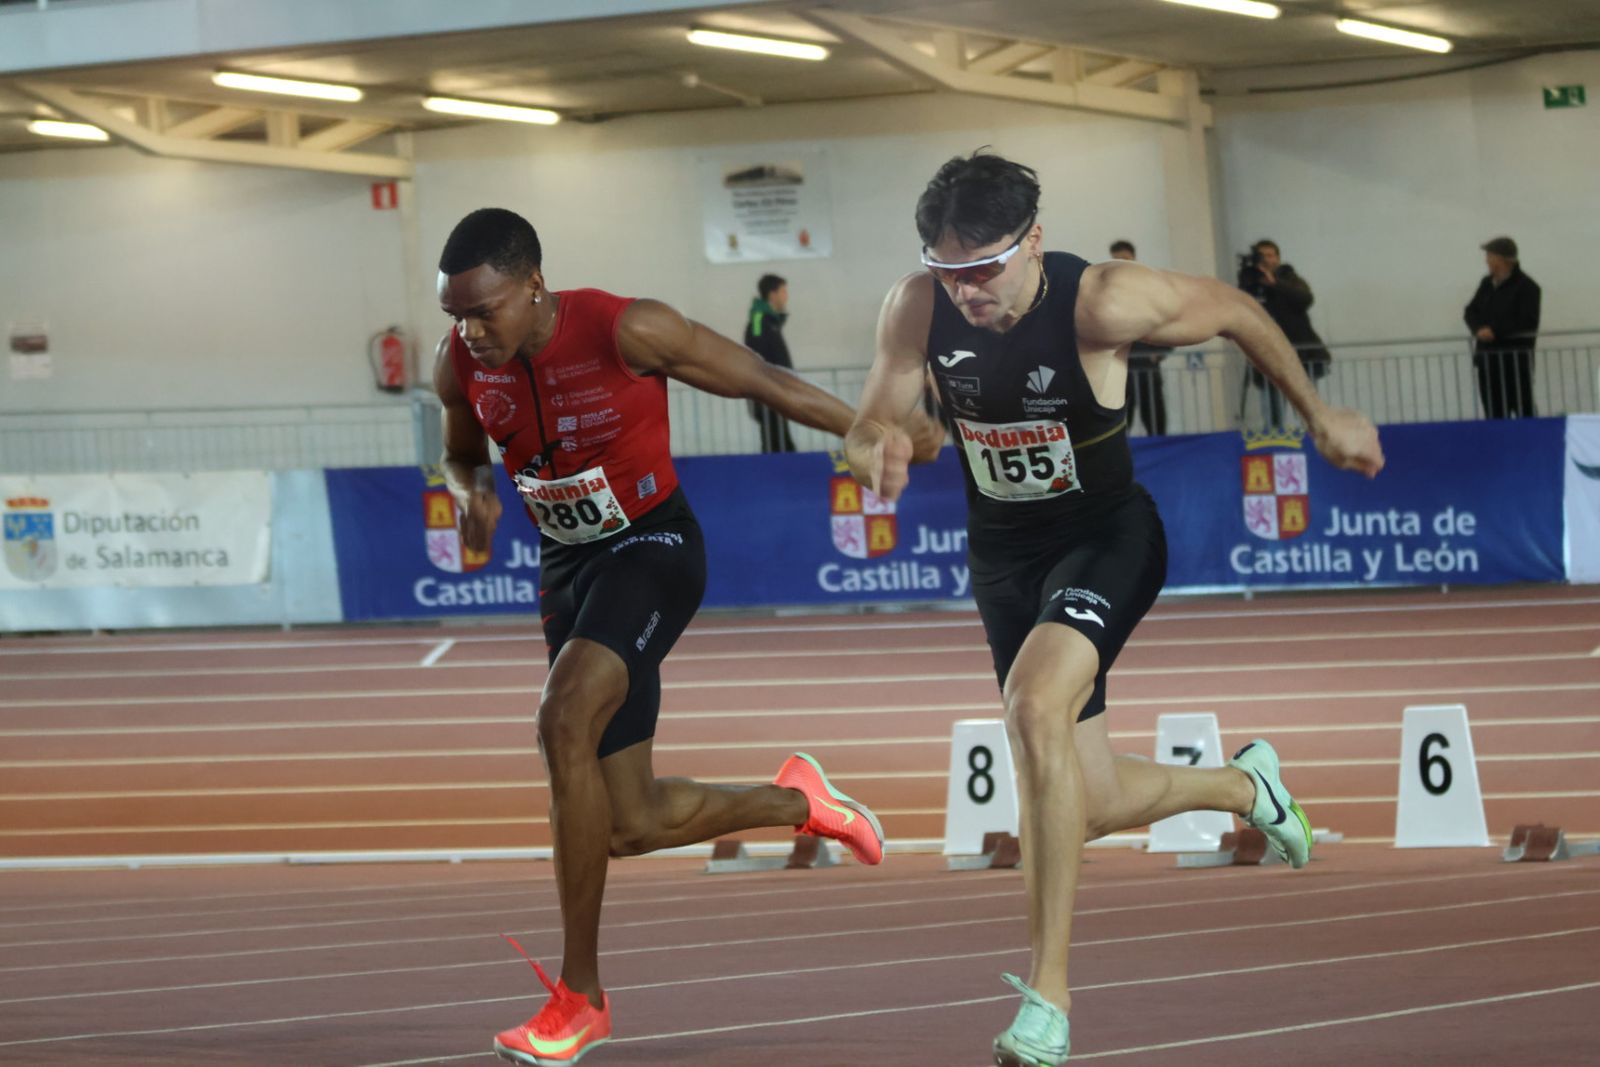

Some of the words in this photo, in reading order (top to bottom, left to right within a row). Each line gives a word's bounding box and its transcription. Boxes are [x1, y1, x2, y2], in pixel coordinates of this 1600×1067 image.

[1022, 397, 1068, 406] Fundación
[1024, 404, 1056, 413] Unicaja
[960, 423, 1067, 449] bedunia
[981, 446, 1055, 484] 155
[529, 477, 607, 501] edunia
[63, 511, 200, 537] Diputación
[535, 498, 603, 531] 280
[1324, 506, 1421, 537] Junta
[1433, 506, 1476, 536] de
[65, 552, 88, 570] de
[96, 545, 230, 570] Salamanca
[1230, 543, 1352, 574] Castilla
[1362, 549, 1383, 580] y
[1395, 542, 1479, 572] León
[414, 575, 535, 607] Castilla
[817, 562, 942, 593] Castilla
[950, 564, 970, 596] y
[967, 745, 995, 804] 8
[1418, 733, 1452, 795] 6
